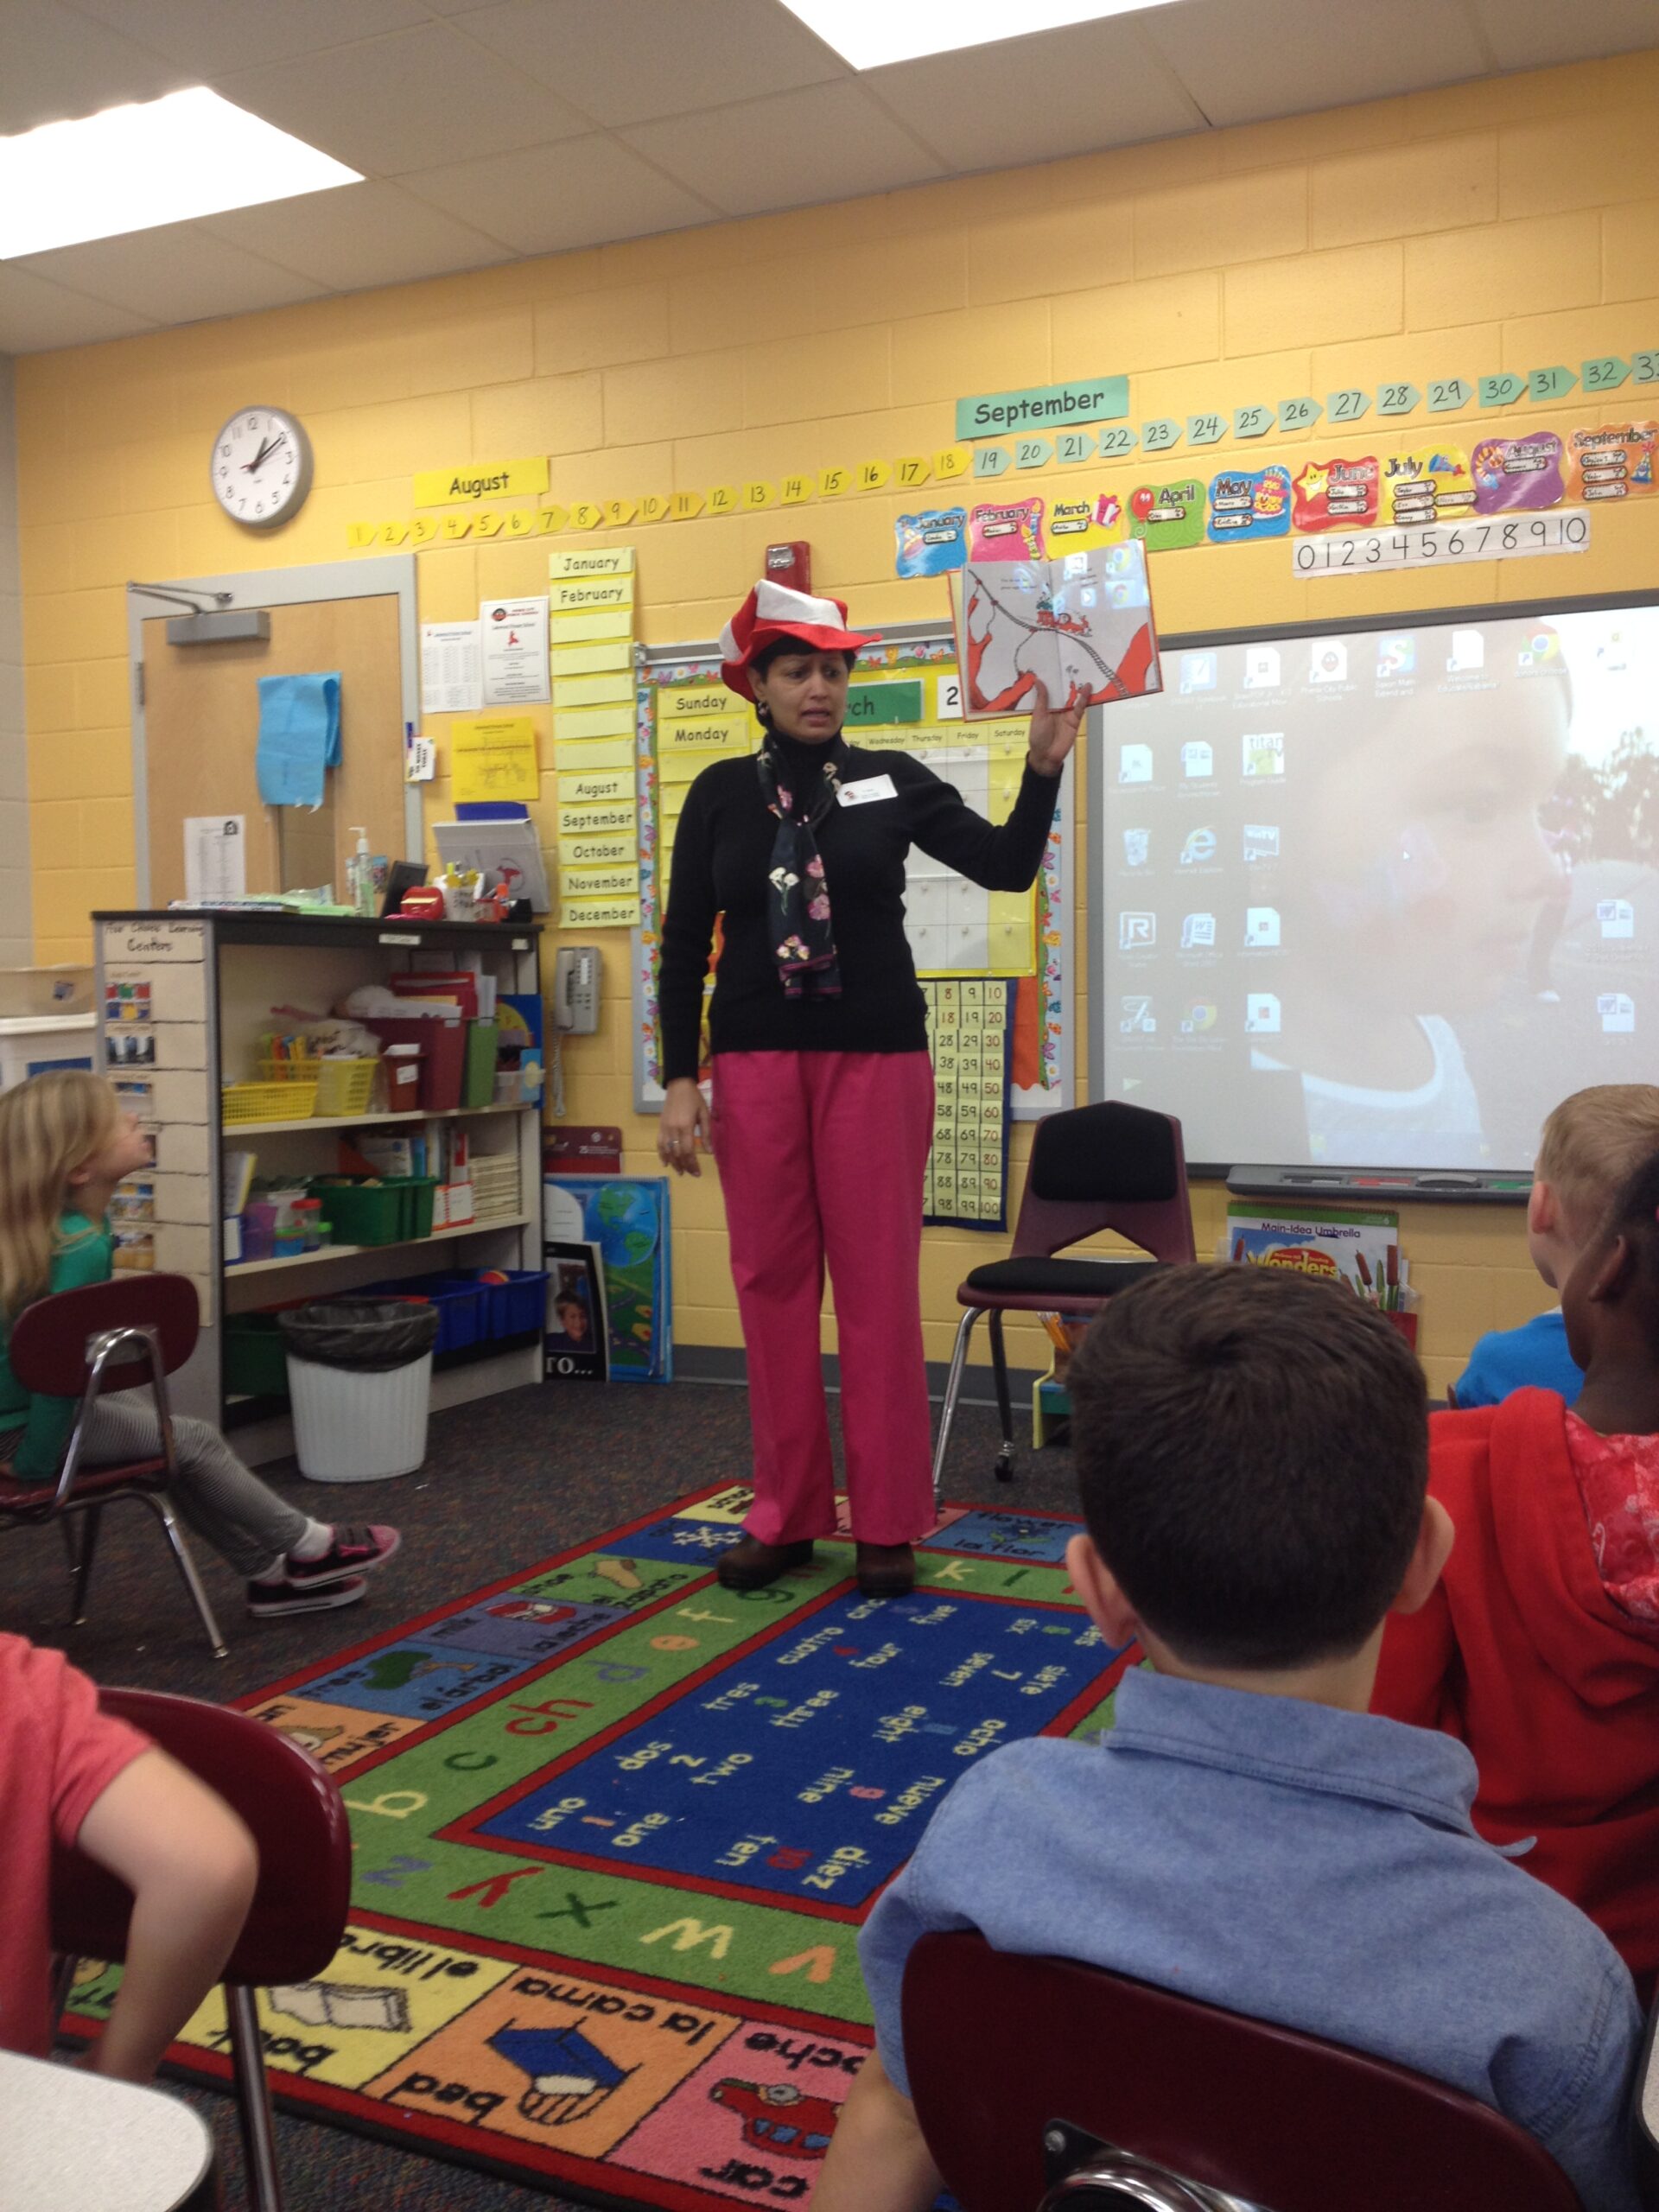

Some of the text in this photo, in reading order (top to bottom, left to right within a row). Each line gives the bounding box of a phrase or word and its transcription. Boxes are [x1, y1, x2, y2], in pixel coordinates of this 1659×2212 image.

[975, 391, 1105, 428] September
[981, 362, 1617, 469] 19 20 21 22 23 24 25 26 27 28 29 30 31 32
[1573, 427, 1659, 448] September
[1330, 463, 1374, 483] June
[1384, 456, 1422, 479] July
[449, 472, 510, 498] August
[1158, 484, 1195, 505] April
[1215, 479, 1252, 497] May
[385, 453, 954, 541] 2 3 4 5 6 7 8 9 10 11 12 13 14 15 16 17 18
[975, 507, 1030, 523] February
[1053, 501, 1090, 517] March
[915, 511, 966, 530] January
[1342, 541, 1355, 566] 2
[1366, 538, 1381, 563] 3
[1393, 536, 1409, 559] 4
[1421, 531, 1437, 557] 5
[1448, 531, 1465, 555] 6
[1476, 526, 1491, 550] 7
[1503, 524, 1518, 549] 8
[1530, 521, 1546, 546] 9
[1560, 517, 1586, 543] 10
[563, 556, 620, 571] January
[560, 588, 624, 603] February
[676, 696, 728, 710] Sunday
[675, 728, 728, 743] Monday
[868, 736, 905, 745] Wednesday
[995, 728, 1026, 737] Saturday
[575, 782, 619, 798] August
[563, 812, 633, 829] September
[573, 845, 625, 858] October
[569, 876, 633, 890] November
[569, 907, 635, 921] December
[944, 988, 1001, 1000] 8 9 10
[941, 1013, 1002, 1023] 18 19 20
[939, 1036, 1000, 1047] 28 29 30
[939, 1058, 1000, 1071] 38 39 40
[938, 1083, 1000, 1095] 48 49 50
[938, 1105, 999, 1117] 58 59 60
[936, 1129, 998, 1141] 68 69 70
[936, 1153, 998, 1165] 78 79 80
[937, 1177, 997, 1190] 88 89 90
[938, 1199, 952, 1211] 98
[961, 1200, 976, 1211] 99
[1262, 1223, 1361, 1238] Main-Idea Umbrella
[1246, 1249, 1338, 1279] Wonders
[975, 1510, 1073, 1529] flower
[953, 1539, 1046, 1557] la flor
[908, 1605, 957, 1625] five
[777, 1627, 844, 1664] cuatro
[849, 1642, 903, 1669] four
[939, 1652, 995, 1687] seven
[1020, 1665, 1067, 1695] siete
[296, 1669, 365, 1699] tree
[420, 1695, 453, 1711] el
[702, 1681, 760, 1711] tres
[505, 1698, 594, 1737] ch
[770, 1689, 840, 1728] three
[873, 1705, 927, 1743] eight
[953, 1719, 1007, 1756] ocho
[614, 1741, 672, 1770] dos
[670, 1753, 708, 1768] 2
[690, 1752, 753, 1785] two
[798, 1767, 855, 1804] nine
[874, 1775, 946, 1825] nueve
[526, 1797, 587, 1830] uno
[612, 1811, 671, 1847] one
[715, 1834, 779, 1866] ten
[803, 1847, 871, 1890] diez
[418, 1956, 480, 1980] el
[512, 1975, 716, 2045] la cama
[745, 2031, 865, 2074] oche
[383, 2072, 507, 2126] bed
[698, 2159, 810, 2198] car
